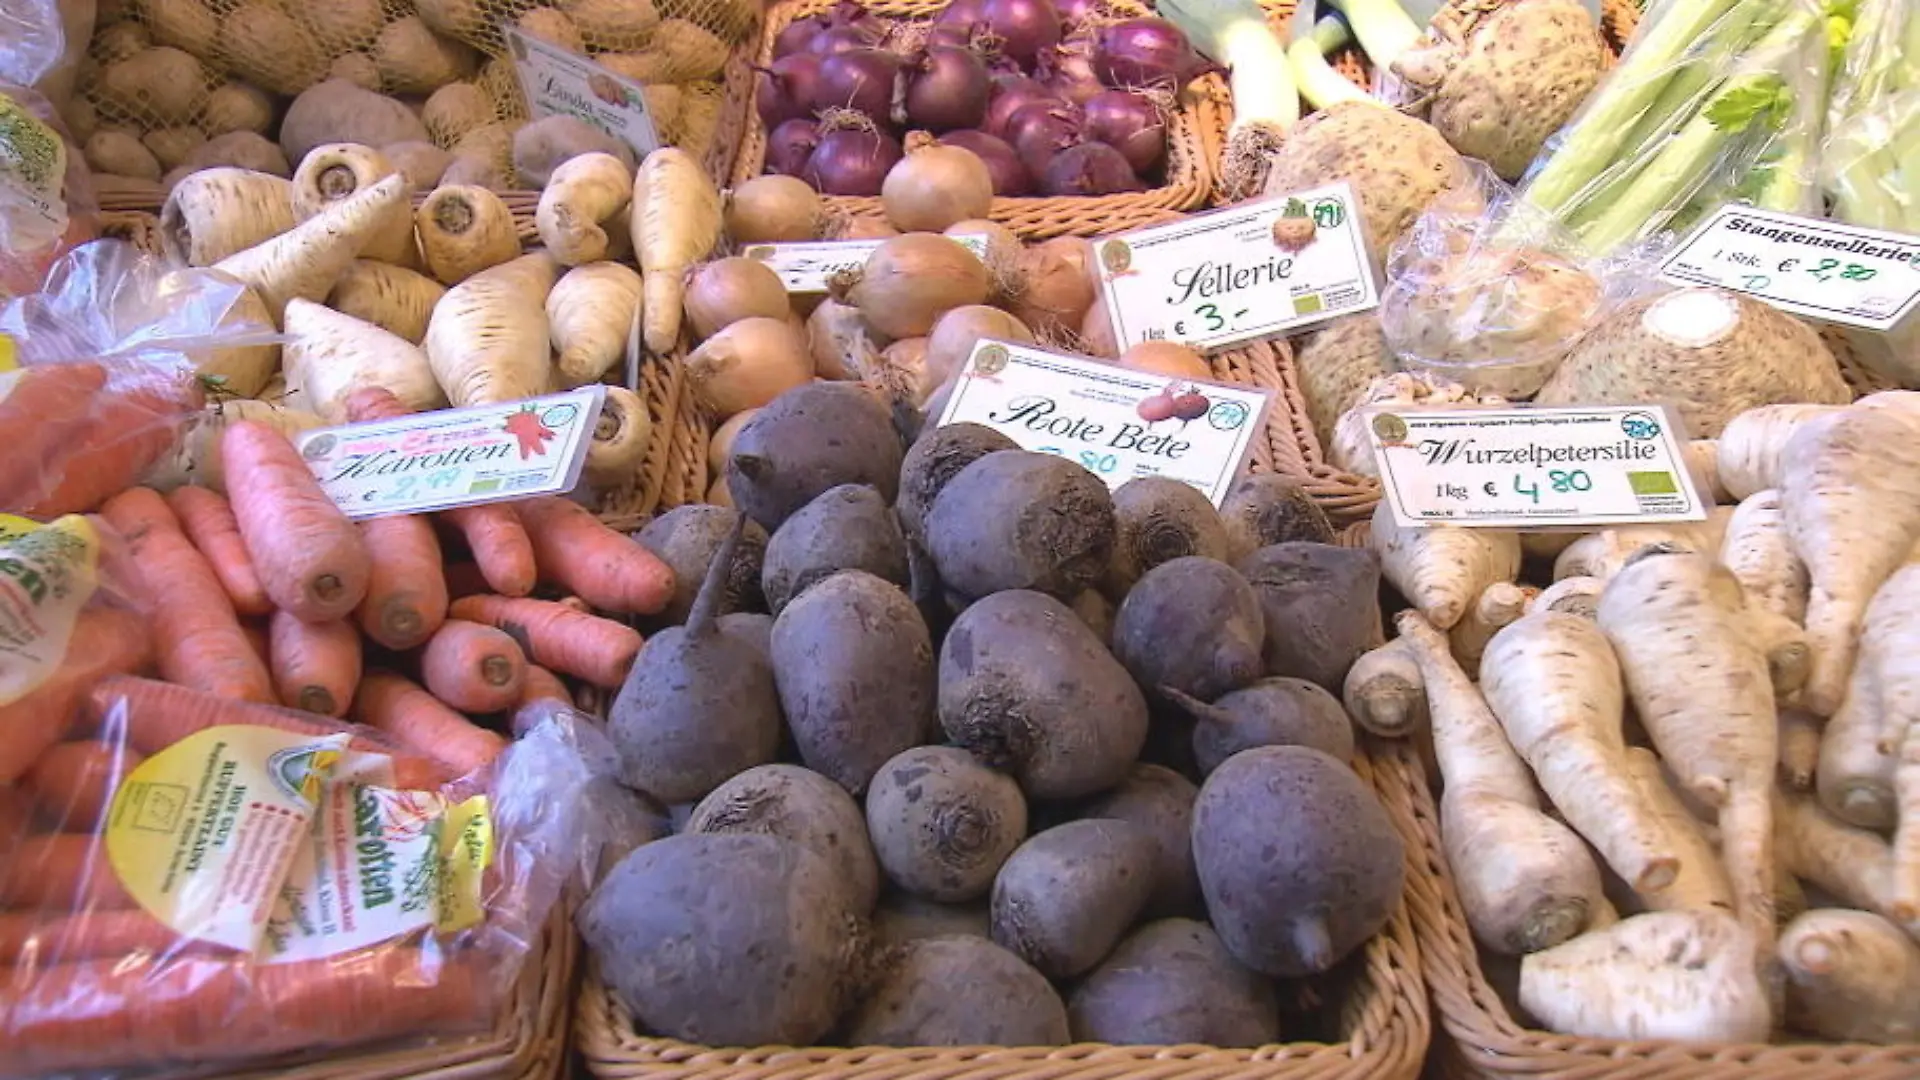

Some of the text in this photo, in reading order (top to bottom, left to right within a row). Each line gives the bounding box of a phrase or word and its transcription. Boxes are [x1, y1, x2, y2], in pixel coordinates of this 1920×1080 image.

[1725, 217, 1913, 263] Stangensellerie
[1777, 258, 1800, 273] €
[1166, 256, 1293, 305] Sellerie
[1174, 321, 1186, 335] €
[988, 394, 1104, 442] Rote
[1109, 422, 1191, 460] Bete
[1418, 439, 1656, 468] Wurzelpetersilie
[1445, 484, 1469, 500] kg
[1484, 482, 1498, 498] €
